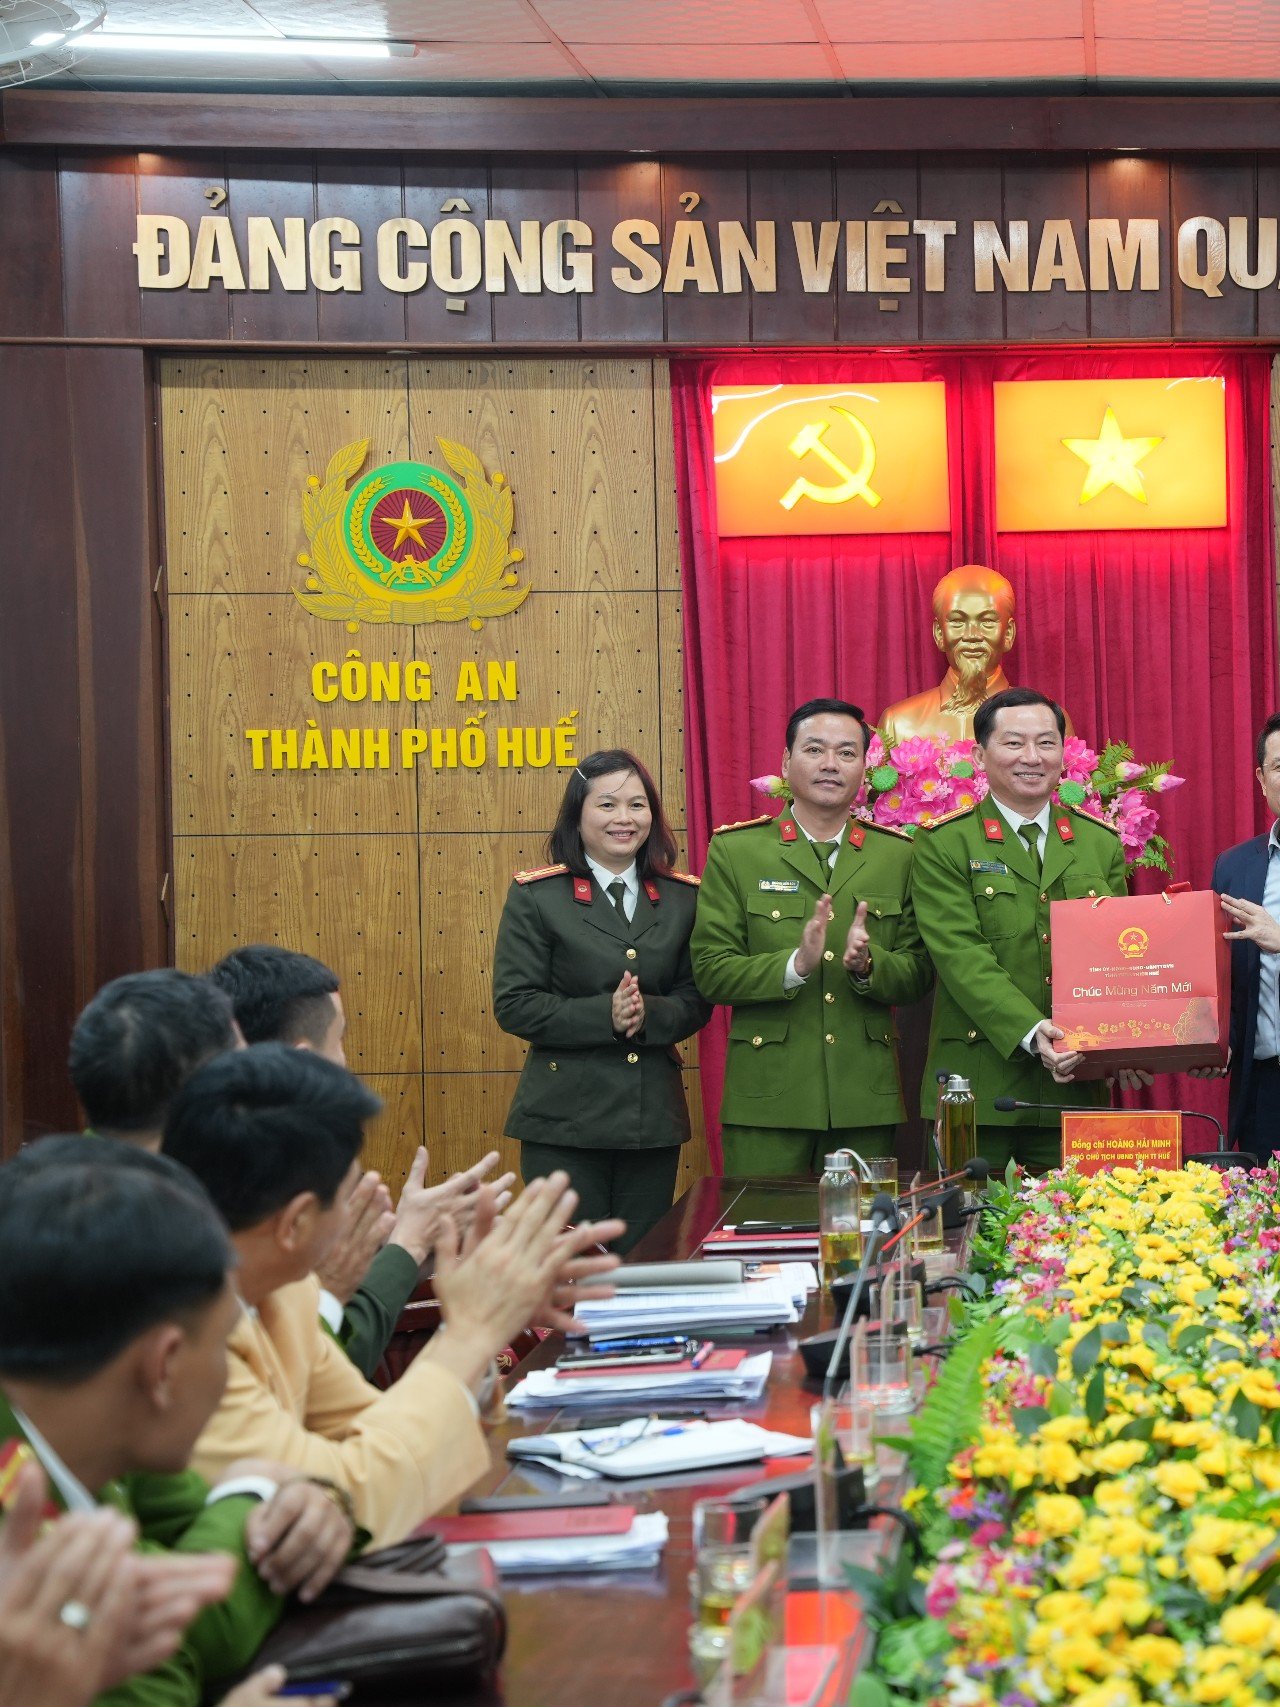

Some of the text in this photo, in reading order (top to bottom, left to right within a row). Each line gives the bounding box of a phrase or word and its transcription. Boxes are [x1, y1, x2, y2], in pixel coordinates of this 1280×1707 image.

[133, 186, 361, 292] ĐẢNG
[377, 198, 593, 312] CỘNG
[611, 191, 777, 294] SẢN
[792, 199, 956, 311] VIỆT
[973, 218, 1159, 292] NAM
[311, 649, 517, 702] CÔNG AN
[246, 710, 578, 769] THÀNH PHỐ HUẾ
[1073, 982, 1192, 998] Chúc Mừng Năm Mới
[1093, 1140, 1105, 1148] chí
[1107, 1138, 1134, 1148] HOÀNG
[1137, 1137, 1149, 1148] HẢI
[1152, 1140, 1171, 1148] MINH
